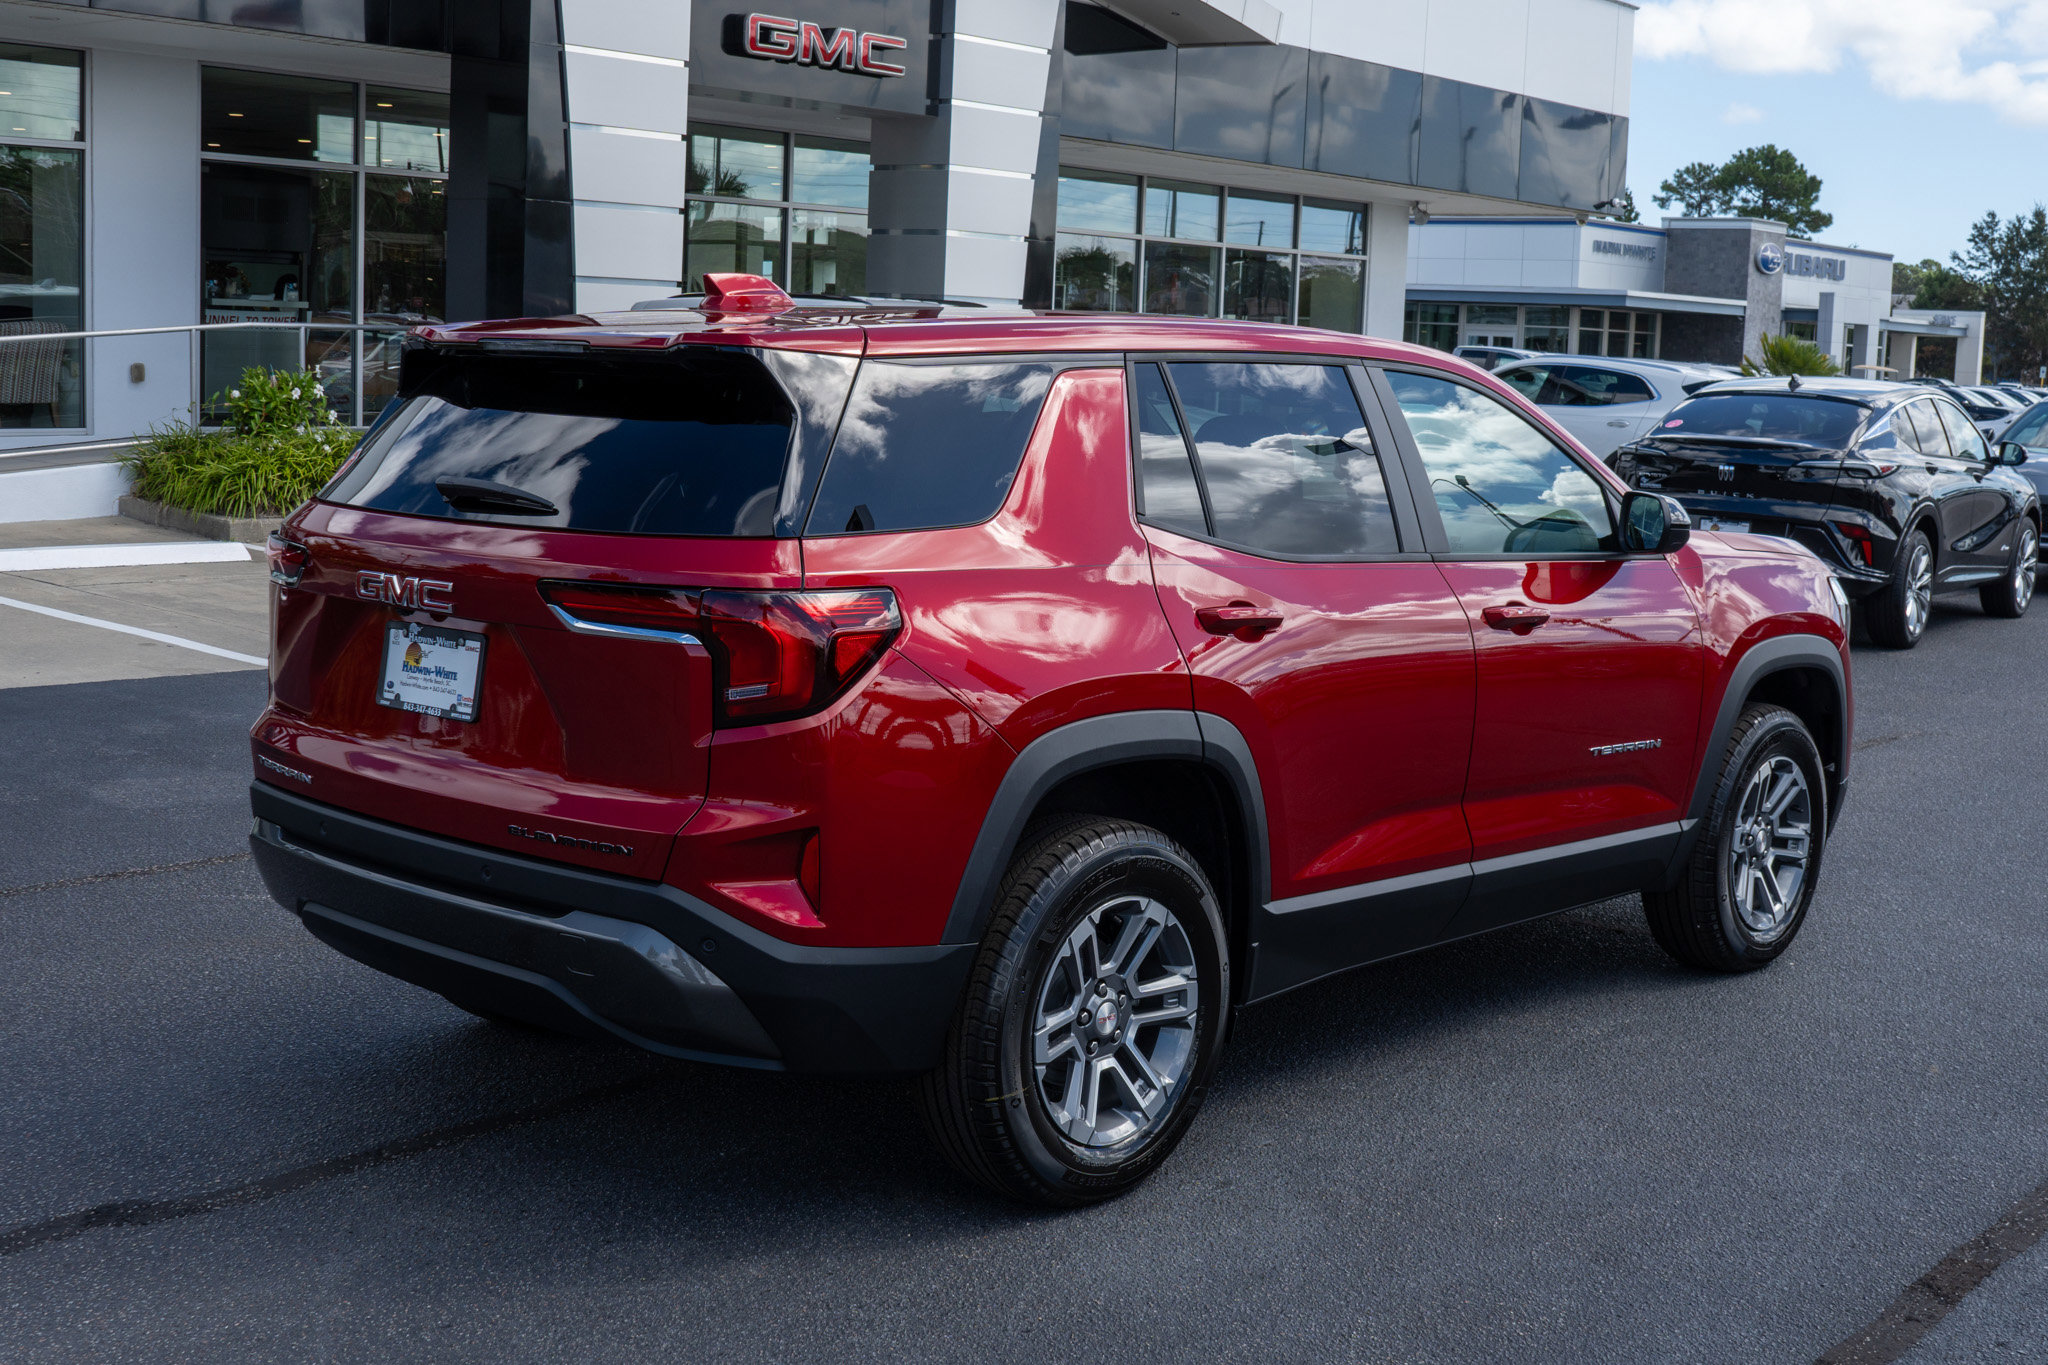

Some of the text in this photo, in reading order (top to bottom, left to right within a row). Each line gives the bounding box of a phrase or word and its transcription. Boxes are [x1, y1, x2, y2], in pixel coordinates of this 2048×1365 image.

[746, 12, 907, 76] GMC
[1697, 489, 1754, 499] BUICK
[356, 570, 453, 613] GMC
[402, 661, 458, 680] HADWIN-WHITE
[403, 702, 442, 716] 843-347-4633
[1589, 738, 1662, 757] TERRAIN
[257, 754, 312, 784] TERRAIN
[508, 825, 633, 856] ELEVATION
